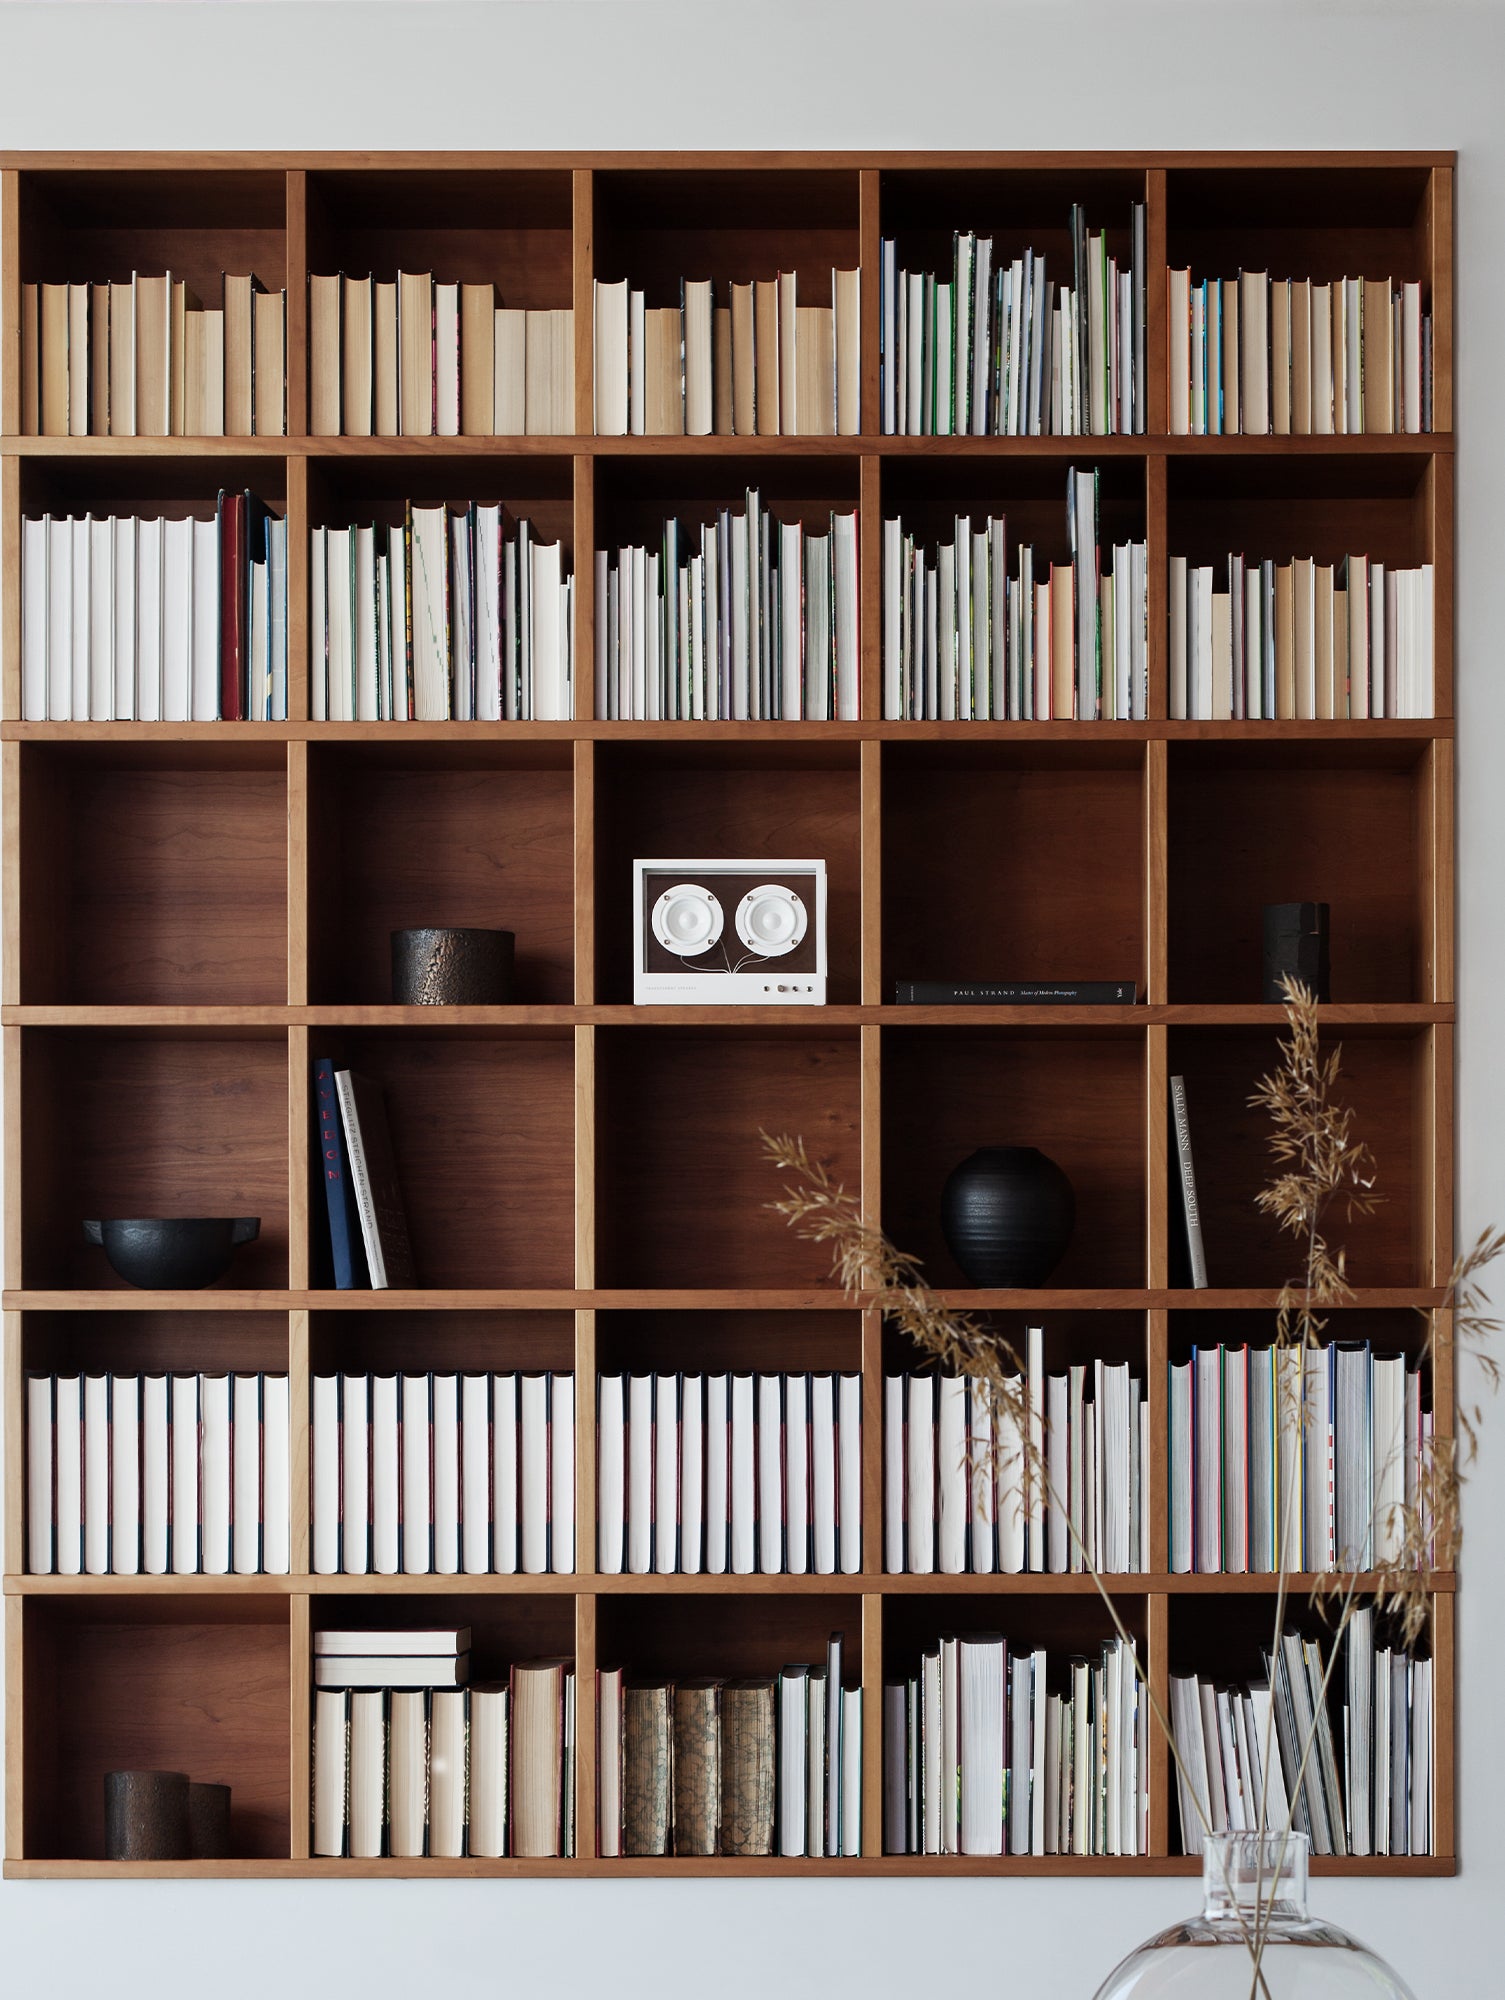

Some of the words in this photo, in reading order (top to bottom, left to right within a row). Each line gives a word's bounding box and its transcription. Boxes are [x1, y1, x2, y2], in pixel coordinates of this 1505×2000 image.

[1174, 1084, 1186, 1115] SALLY
[319, 1071, 340, 1180] AVEDON
[1178, 1118, 1190, 1151] MANN
[343, 1084, 357, 1134] STIEGLITZ
[351, 1136, 365, 1186] STEICHEN
[361, 1188, 374, 1229] STRAND
[1183, 1161, 1194, 1188] DEEP
[1186, 1190, 1199, 1227] SOUTH
